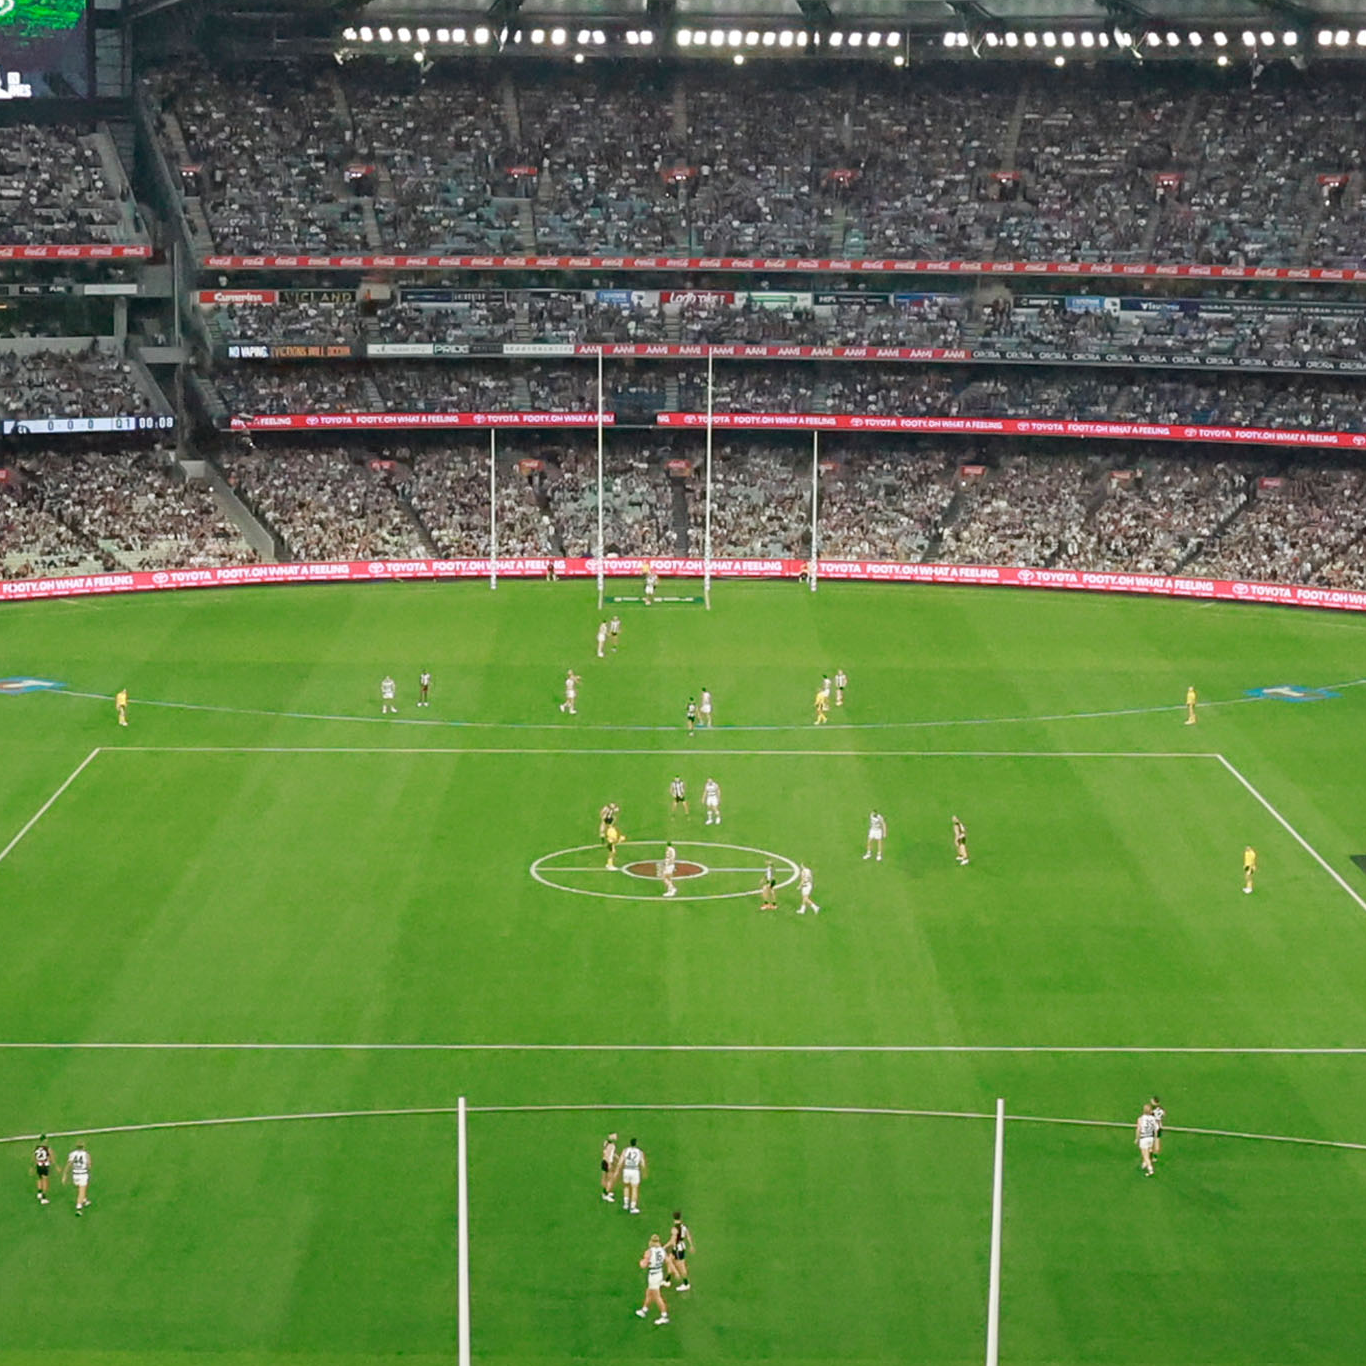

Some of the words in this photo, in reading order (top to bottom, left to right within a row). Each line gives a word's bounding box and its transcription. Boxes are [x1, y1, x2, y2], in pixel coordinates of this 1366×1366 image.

[214, 292, 263, 302] Cummins
[172, 570, 210, 581] TOYOTA
[269, 565, 298, 576] WHAT
[310, 563, 348, 574] FEELING
[821, 562, 860, 572] TOYOTA
[919, 566, 948, 575] WHAT
[959, 567, 998, 578] FEELING
[56, 578, 83, 589] WHAT
[94, 574, 132, 586] FEELING
[1037, 571, 1076, 582] TOYOTA
[1135, 576, 1163, 587] WHAT
[1174, 579, 1213, 591] FEELING
[1252, 585, 1290, 597] TOYOTA
